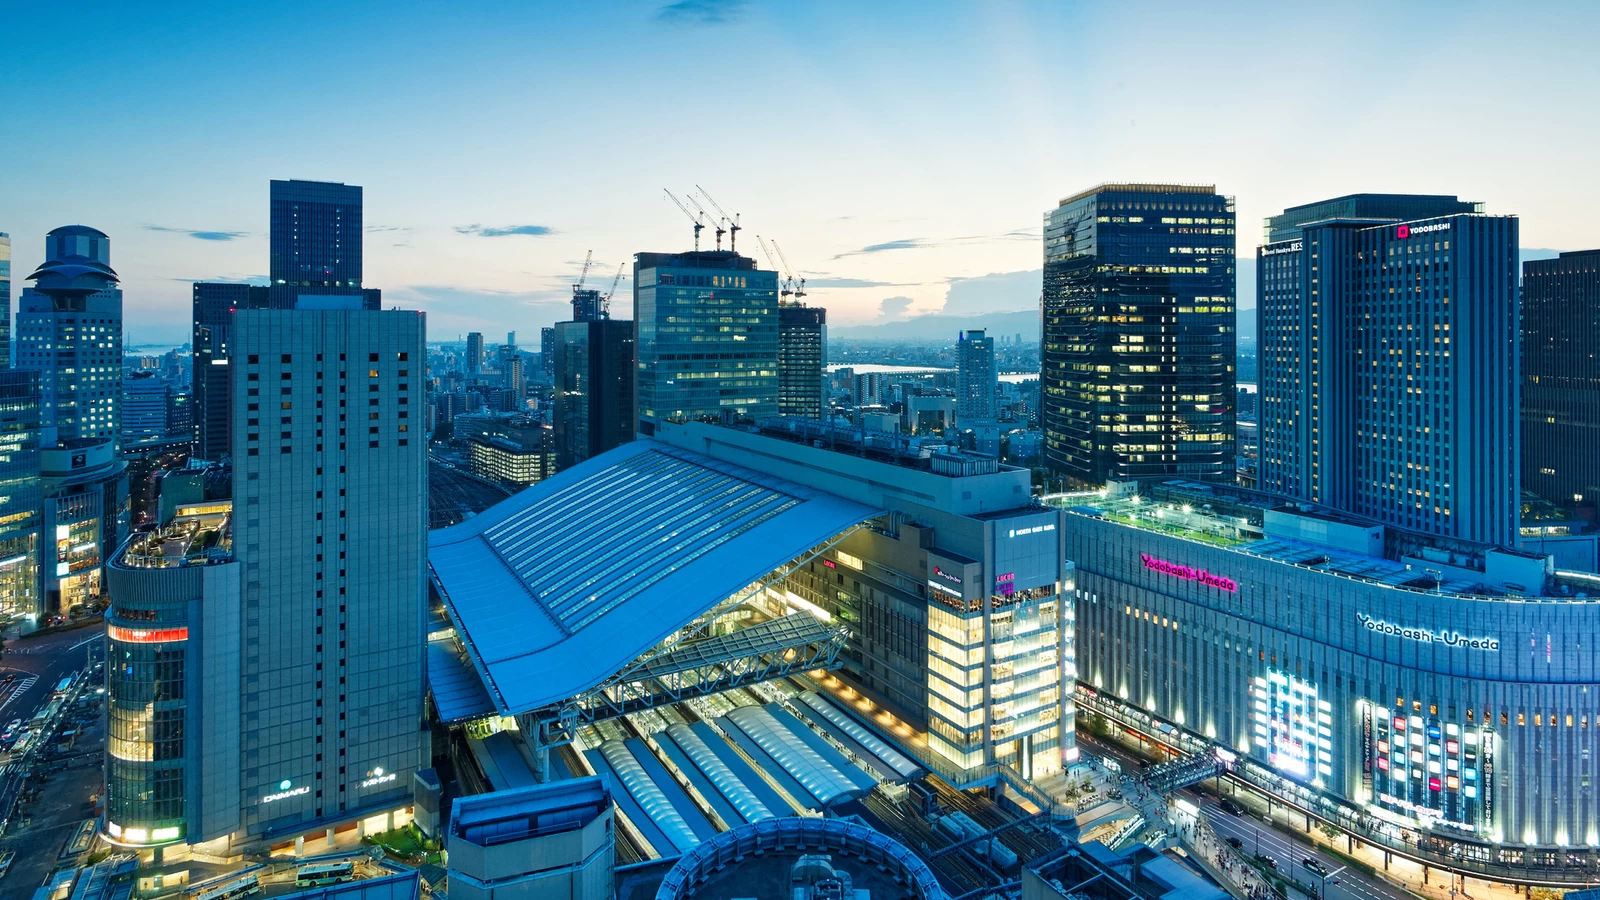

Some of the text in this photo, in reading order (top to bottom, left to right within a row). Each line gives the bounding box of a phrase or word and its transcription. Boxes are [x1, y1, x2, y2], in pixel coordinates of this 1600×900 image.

[1410, 223, 1450, 234] YODOBASHI
[1141, 555, 1235, 591] Yodobashi-Umeda
[1357, 613, 1499, 650] Yodobashi-Umeda
[264, 786, 310, 803] DAIMARU
